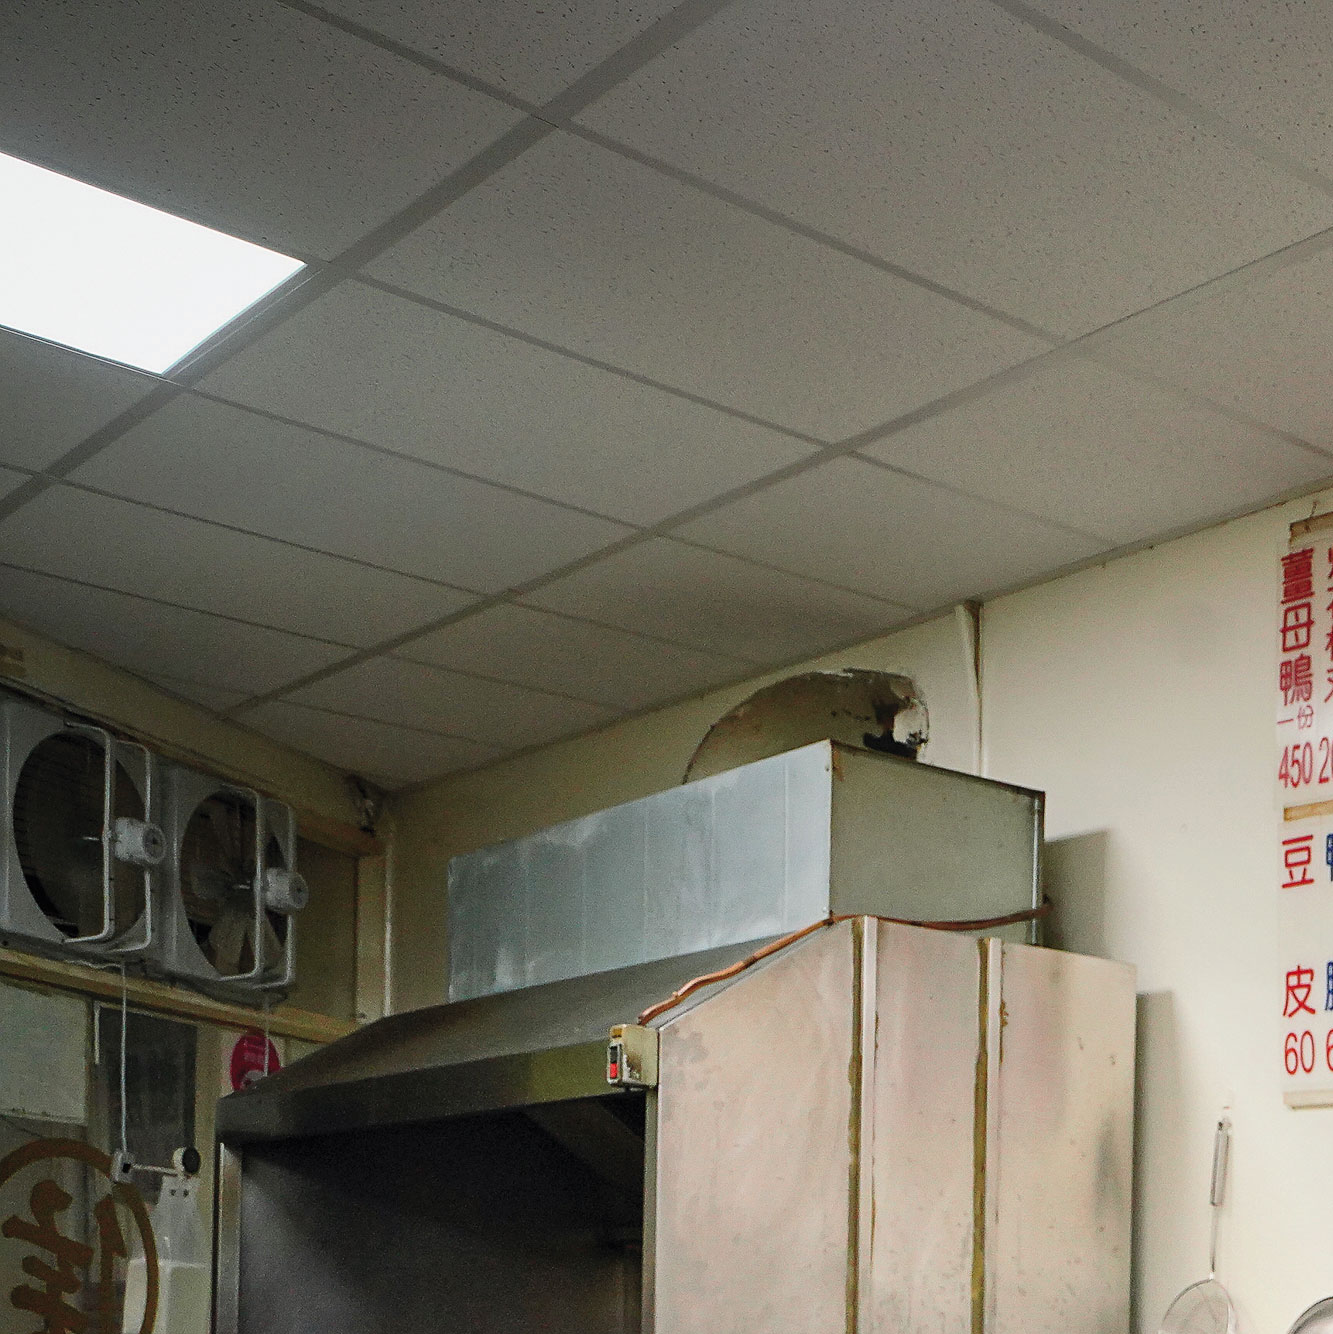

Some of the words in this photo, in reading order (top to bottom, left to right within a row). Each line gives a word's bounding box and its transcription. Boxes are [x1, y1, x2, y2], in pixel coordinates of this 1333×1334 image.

[1279, 547, 1315, 706] 薑母鴨
[1277, 704, 1314, 730] 一份
[1278, 741, 1314, 789] 450
[1280, 833, 1316, 1018] 豆皮
[1283, 1029, 1315, 1075] 60
